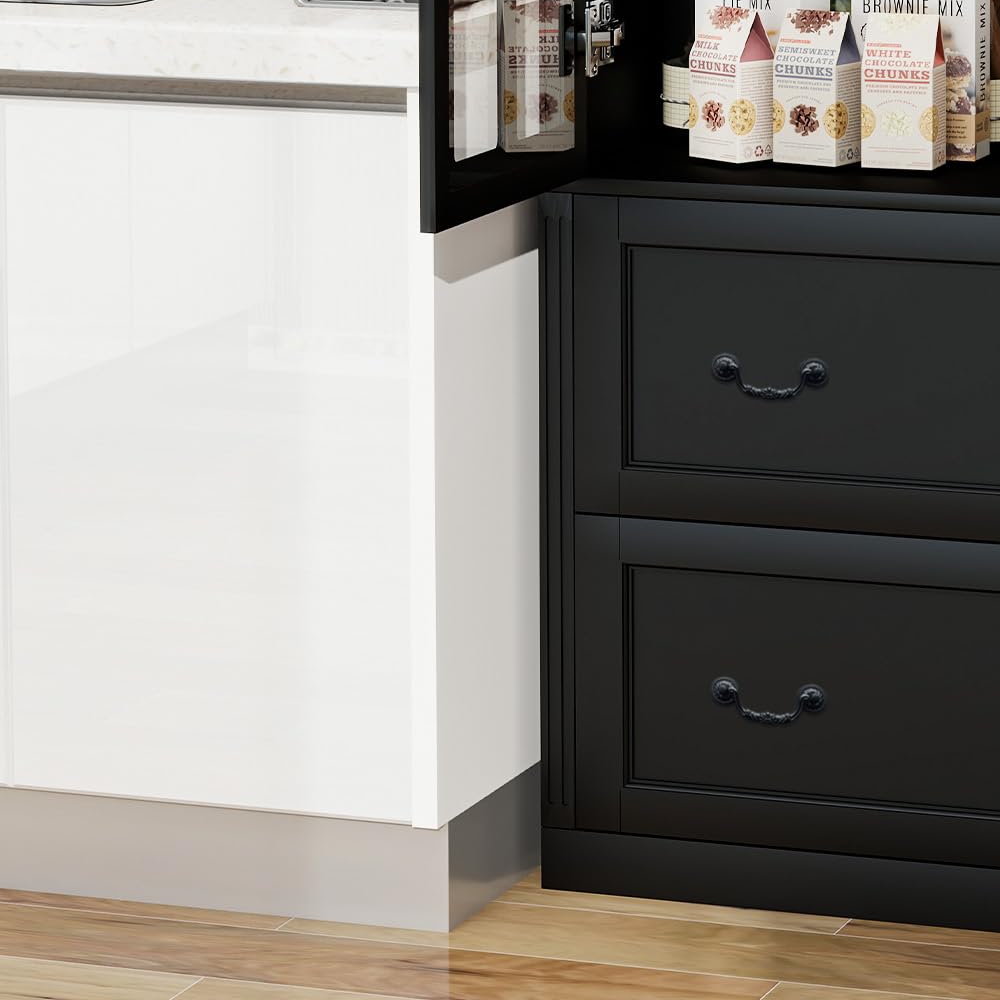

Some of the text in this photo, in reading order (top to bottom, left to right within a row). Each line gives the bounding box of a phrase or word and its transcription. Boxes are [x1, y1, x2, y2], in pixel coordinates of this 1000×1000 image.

[938, 0, 963, 16] MIX
[695, 41, 720, 51] MILK
[778, 46, 837, 56] SEMISWEET
[691, 51, 738, 62] CHOCOLATE
[866, 49, 912, 59] WHITE
[776, 55, 834, 65] CHOCOLATE
[865, 60, 931, 68] CHOCOLATE
[690, 60, 736, 74] CHUNKS
[775, 64, 833, 76] CHUNKS
[864, 68, 930, 80] CHUNKS
